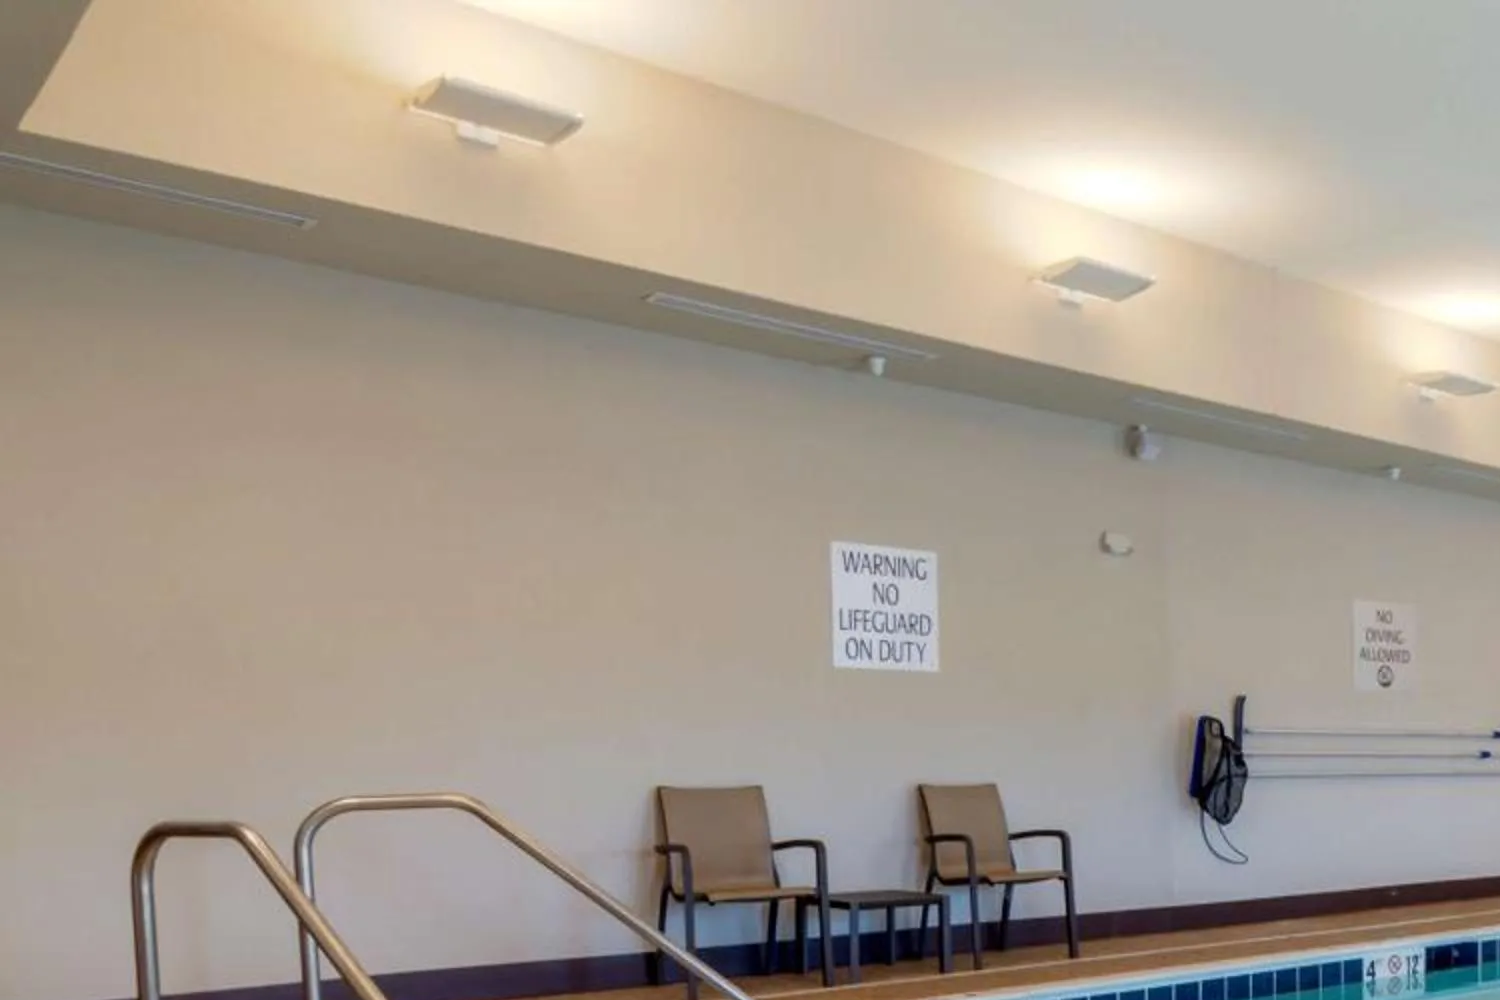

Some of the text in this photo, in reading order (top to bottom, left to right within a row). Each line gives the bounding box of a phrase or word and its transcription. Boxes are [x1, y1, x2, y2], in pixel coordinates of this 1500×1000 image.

[841, 549, 928, 581] WARNING
[872, 582, 900, 606] NO
[838, 607, 932, 637] LIFEGUARD
[1376, 609, 1394, 624] NO
[1365, 627, 1405, 645] DIVING
[845, 637, 928, 664] ON DUTY
[1359, 646, 1412, 664] ALLOWED
[1366, 959, 1377, 977] 4
